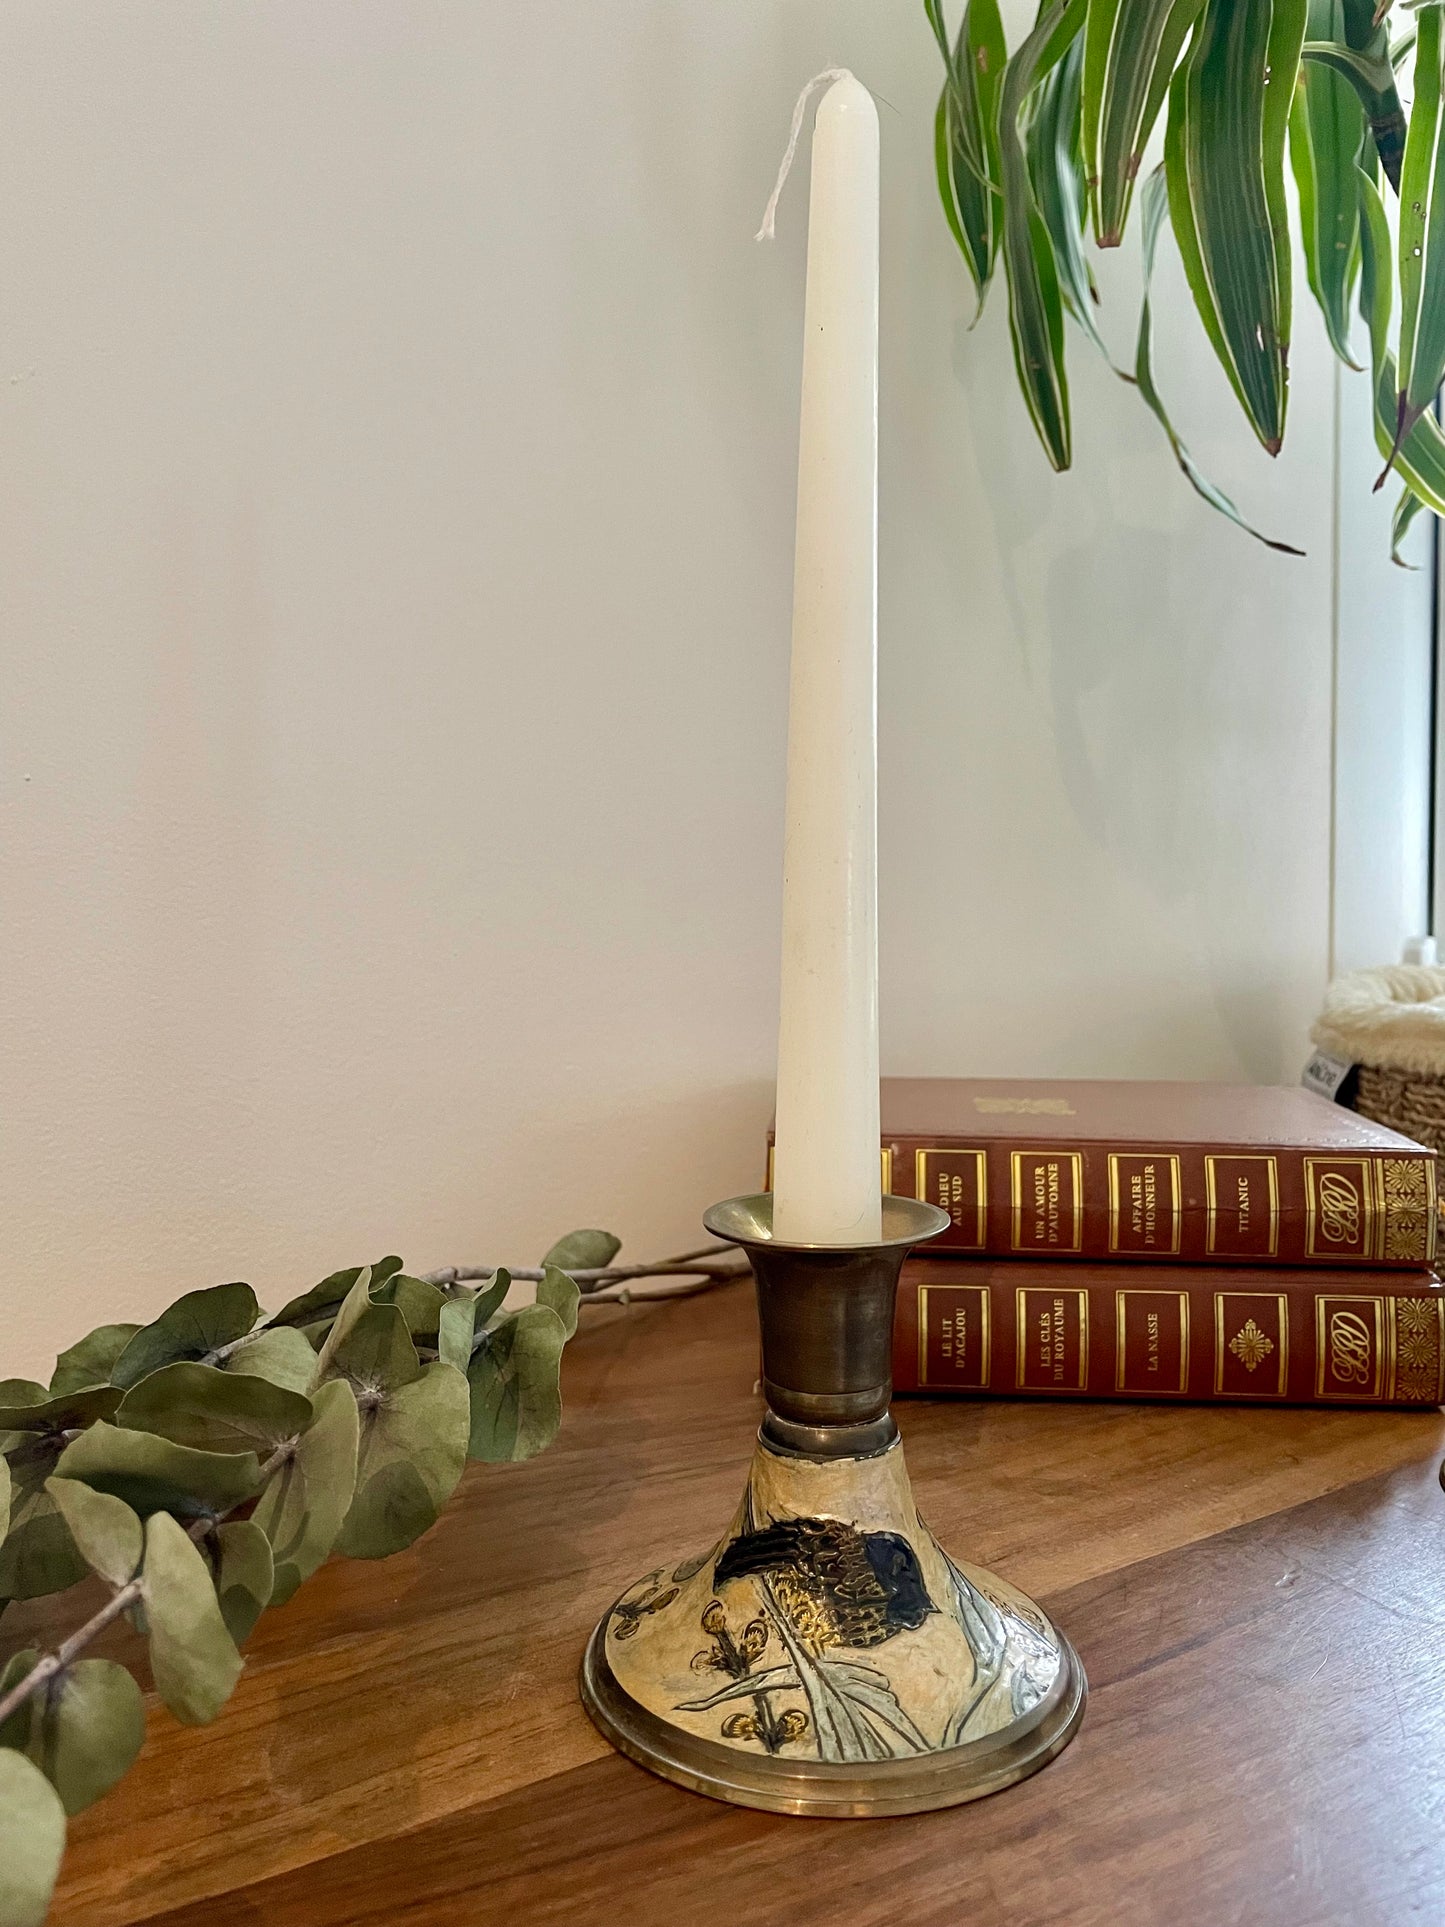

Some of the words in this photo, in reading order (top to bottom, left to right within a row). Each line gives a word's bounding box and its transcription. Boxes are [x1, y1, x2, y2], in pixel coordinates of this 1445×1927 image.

[939, 1173, 949, 1211] DIEU
[952, 1176, 962, 1202] SUD
[1035, 1166, 1045, 1216] AMOUR
[1048, 1163, 1058, 1242] D'AUTOMNE
[1132, 1175, 1142, 1233] AFFAIRE
[1145, 1165, 1155, 1244] D'HONNEUR
[1238, 1177, 1249, 1233] TITANIC
[952, 1207, 962, 1226] AU
[1035, 1221, 1045, 1239] UN
[942, 1318, 952, 1338] LIT
[955, 1308, 966, 1368] D'ACAJOU
[1038, 1312, 1051, 1343] CLÉS
[1053, 1299, 1064, 1360] ROYAUME
[1147, 1313, 1158, 1351] NASSE
[942, 1342, 952, 1357] LE
[1041, 1346, 1051, 1367] LES
[1147, 1356, 1158, 1371] LA
[1054, 1363, 1064, 1380] DU
